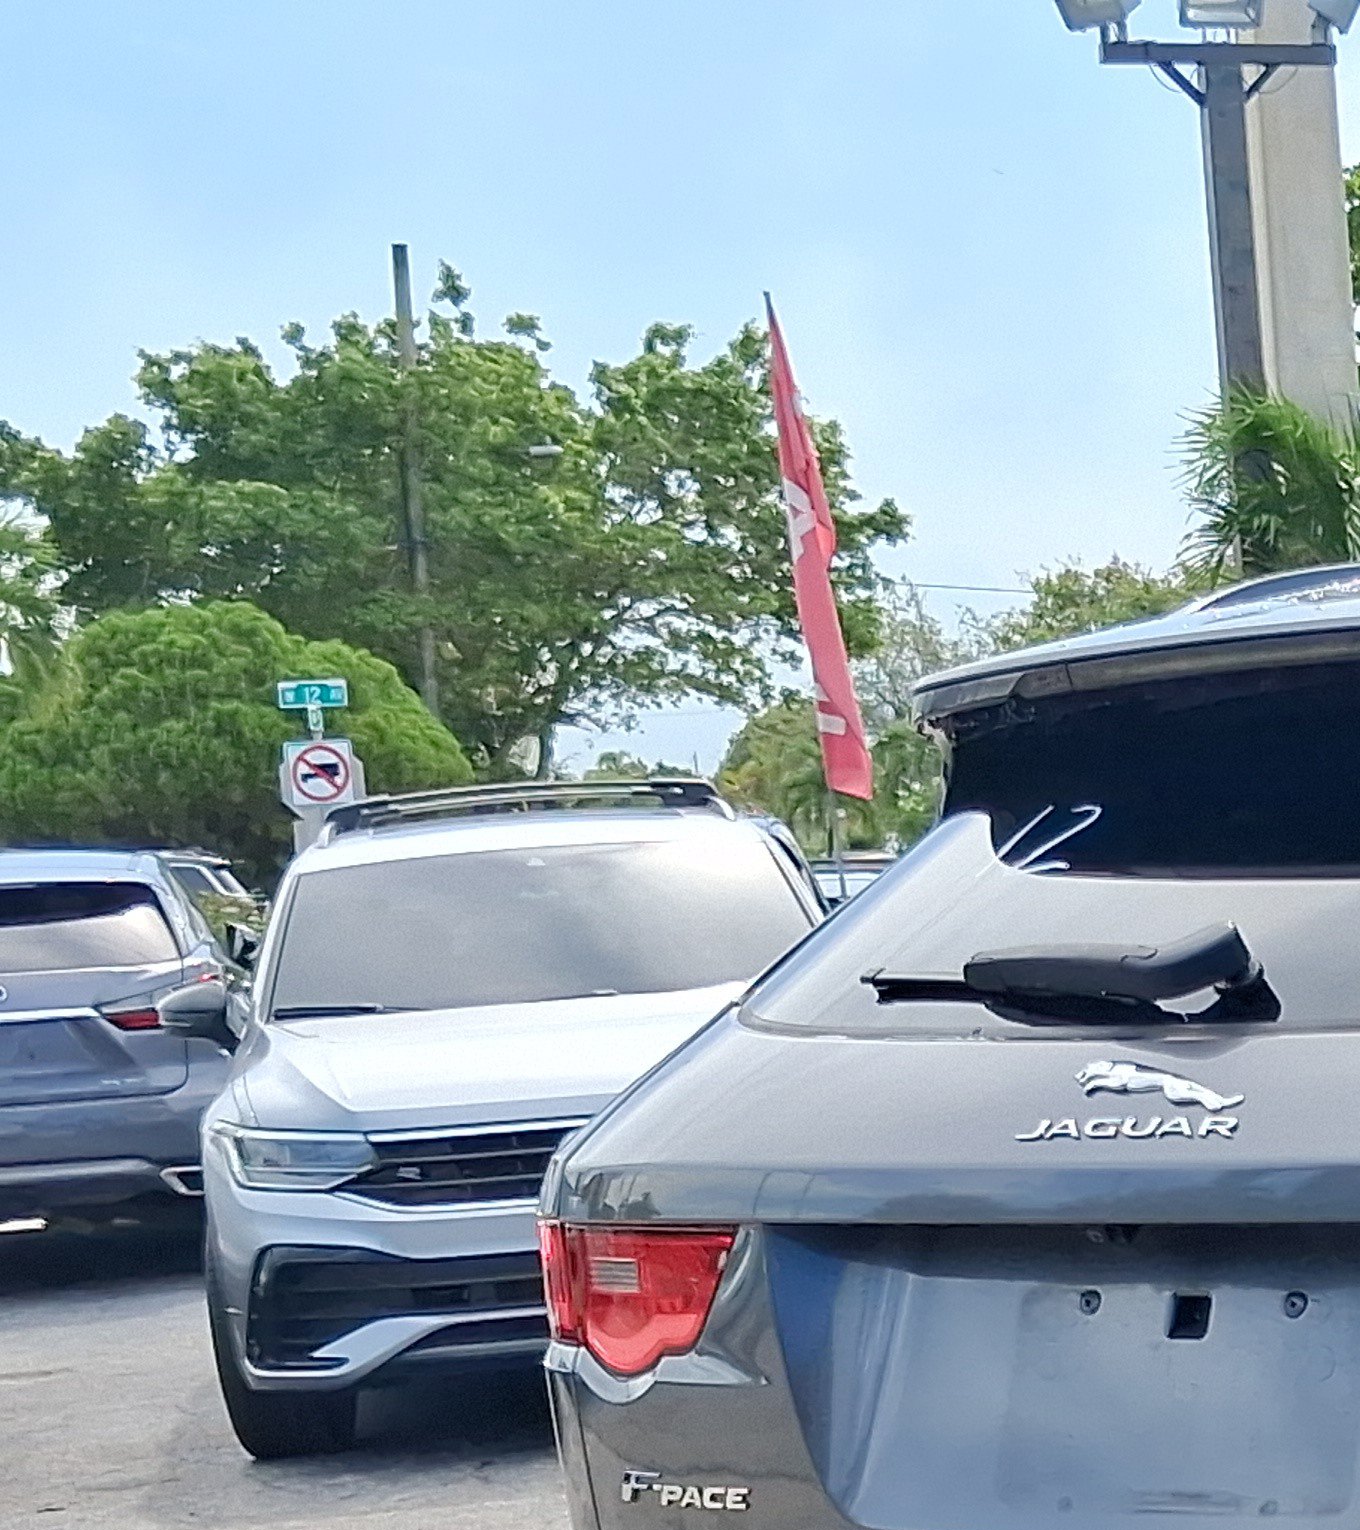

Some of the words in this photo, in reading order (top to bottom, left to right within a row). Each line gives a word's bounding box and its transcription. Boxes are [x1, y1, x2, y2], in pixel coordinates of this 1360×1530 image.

[304, 686, 323, 705] 12
[1014, 1116, 1240, 1141] JAGUAR
[621, 1470, 749, 1511] F-PACE
